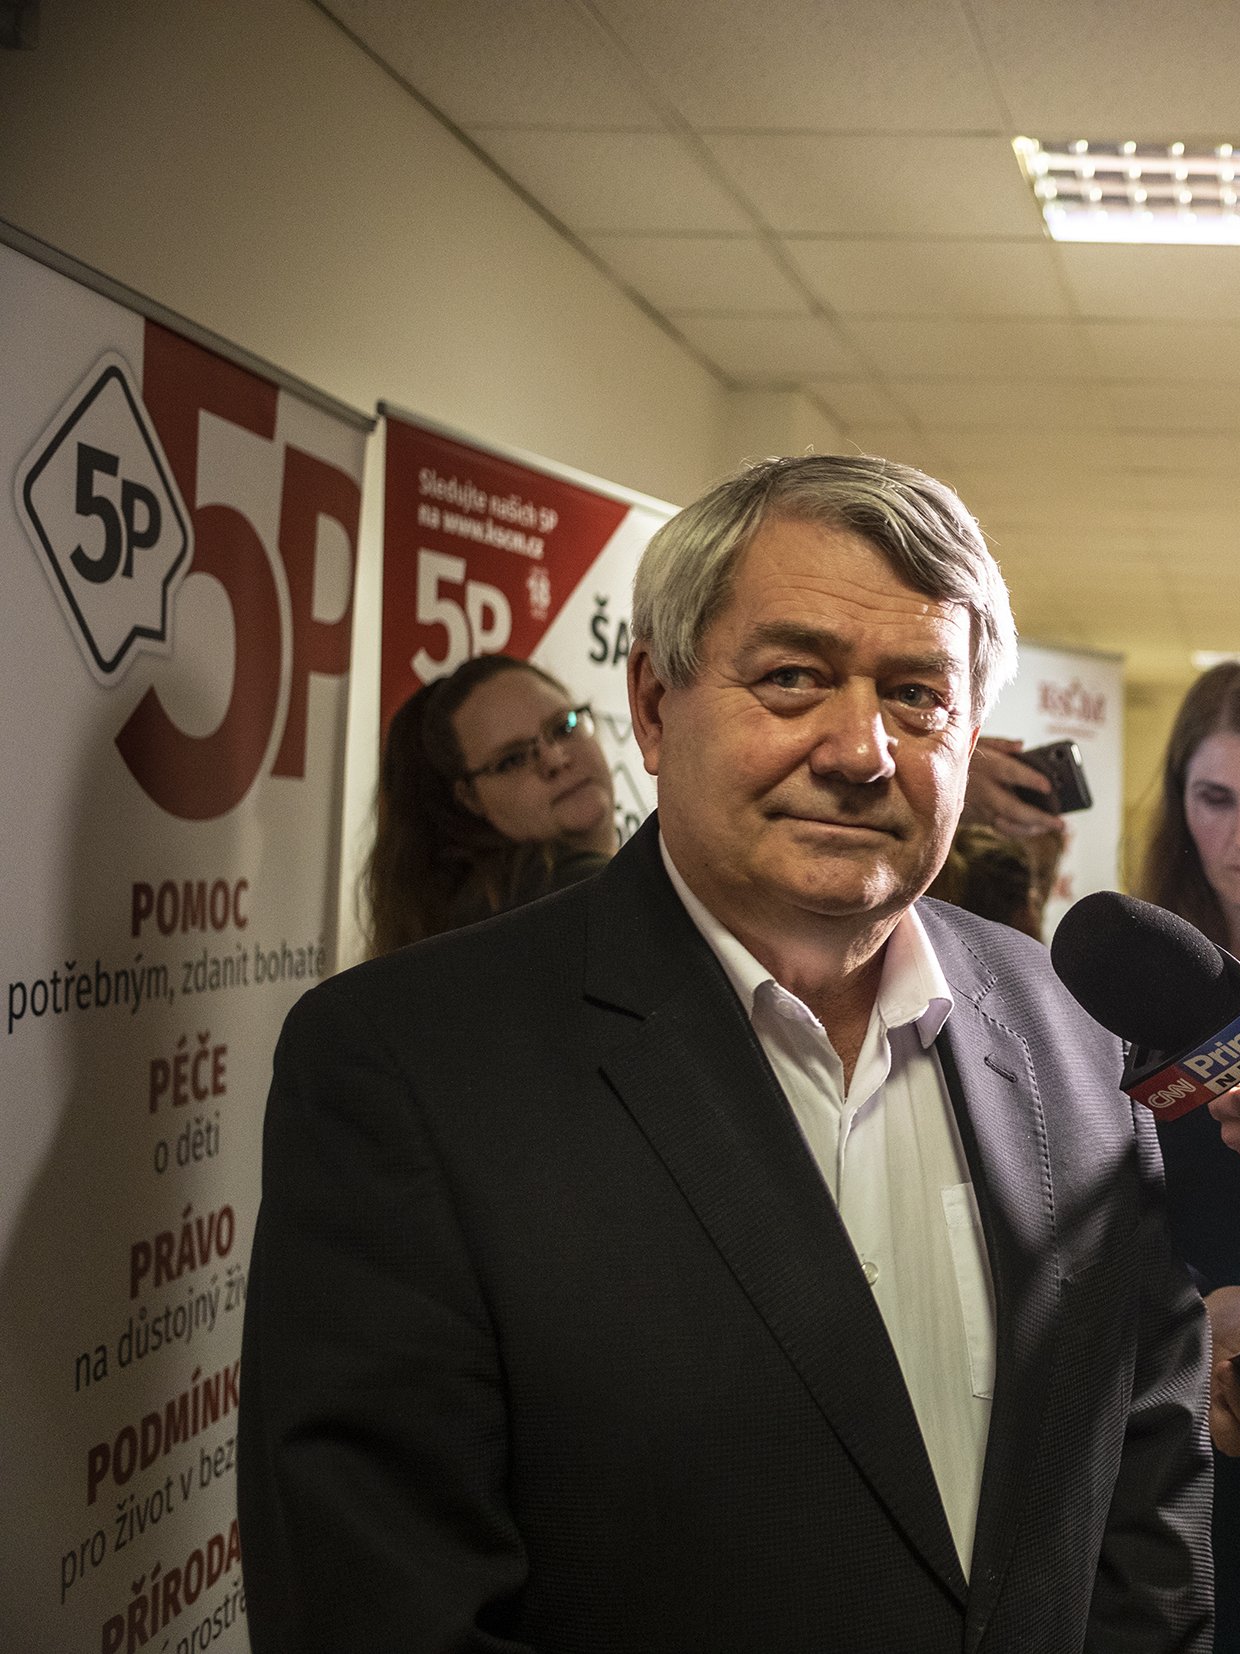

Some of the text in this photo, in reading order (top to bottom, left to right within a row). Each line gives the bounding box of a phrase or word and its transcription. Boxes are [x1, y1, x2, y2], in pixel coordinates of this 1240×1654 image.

[70, 442, 162, 584] 5P
[114, 316, 363, 823] 5P
[411, 548, 513, 687] 5P
[131, 877, 249, 938] POMOC
[8, 953, 175, 1034] potřebným,
[182, 942, 251, 995] zdanit
[150, 1029, 228, 1113] PÉČE
[1147, 1077, 1197, 1109] CNN
[154, 1110, 221, 1175] o děti
[130, 1202, 235, 1299] PRÁVO
[75, 1342, 108, 1393] na
[117, 1273, 221, 1368] důstojný
[61, 1529, 106, 1606] pro
[115, 1475, 174, 1552] život
[180, 1466, 194, 1501] v
